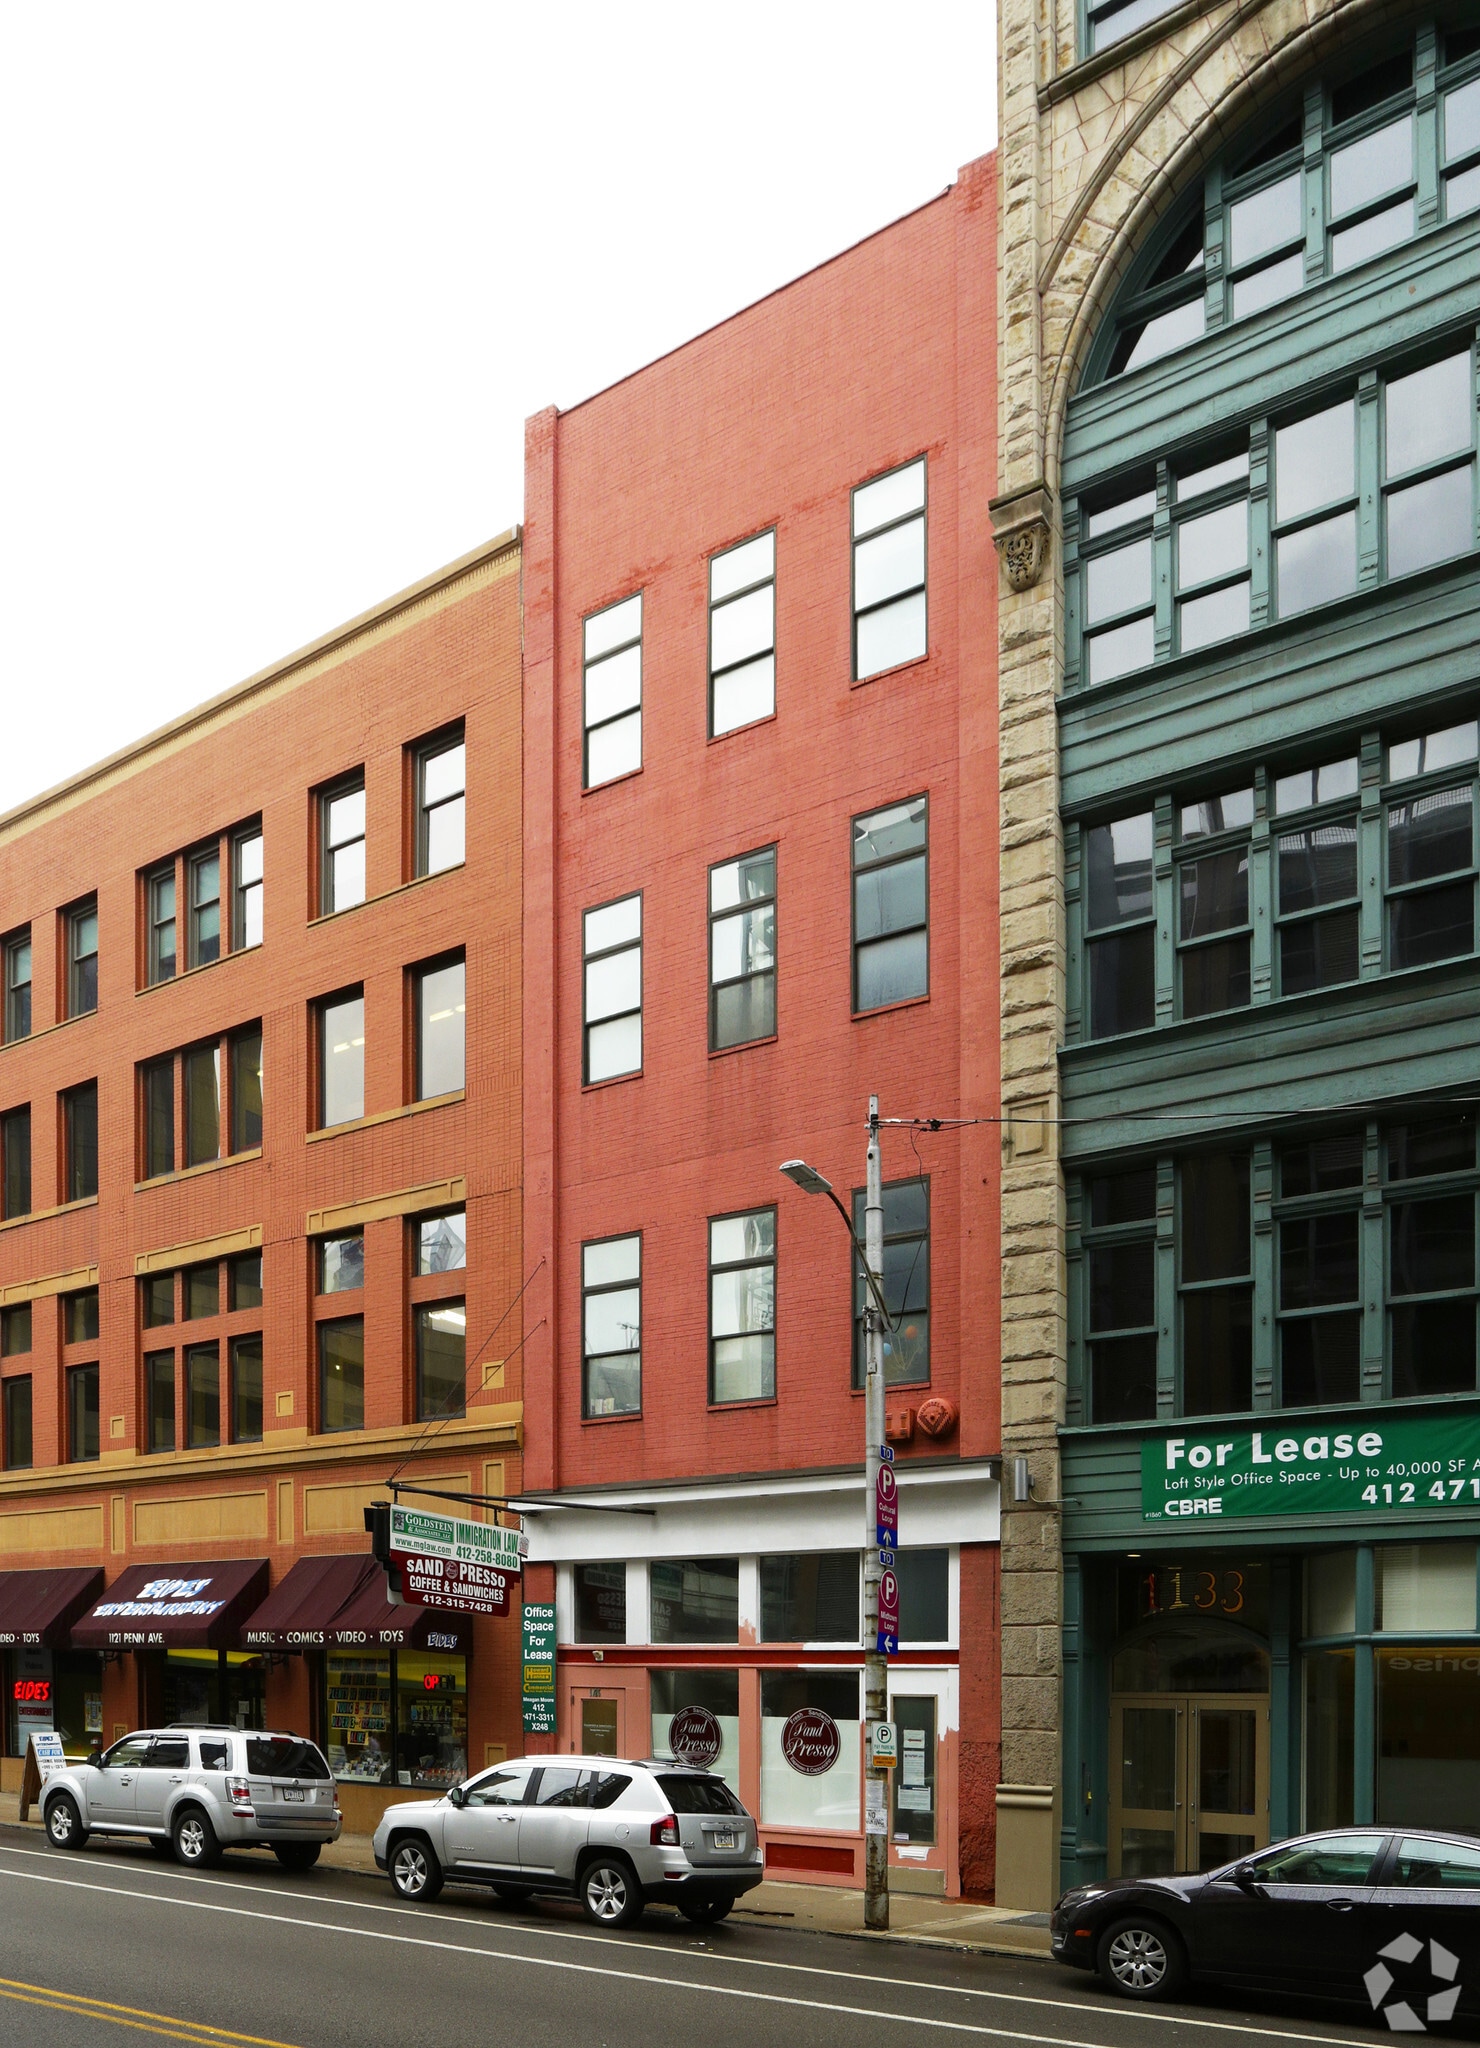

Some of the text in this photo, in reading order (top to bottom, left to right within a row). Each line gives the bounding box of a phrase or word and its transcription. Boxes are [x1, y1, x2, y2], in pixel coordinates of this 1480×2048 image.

[882, 1447, 891, 1459] TO
[1166, 1432, 1383, 1470] For Lease
[883, 1469, 892, 1493] P
[1164, 1476, 1189, 1490] Loft
[1194, 1475, 1225, 1490] Style
[1231, 1472, 1273, 1485] Office
[1279, 1470, 1321, 1485] Space
[1340, 1467, 1360, 1481] Up
[1366, 1466, 1380, 1477] to
[1386, 1461, 1441, 1477] 40,000
[1448, 1459, 1466, 1472] SF
[1361, 1478, 1480, 1504] 412 471
[879, 1502, 896, 1515] Cultural
[1164, 1497, 1223, 1516] CBRE
[405, 1513, 453, 1532] GOLDSTEIN
[882, 1513, 893, 1525] Loop
[408, 1526, 414, 1534] &
[395, 1537, 452, 1554] www.mglaw.com
[456, 1523, 519, 1554] IMMIGRATION LAW
[456, 1546, 518, 1568] 412-258-8080
[882, 1553, 892, 1563] TO
[407, 1559, 506, 1588] SAND PRESSO
[410, 1575, 503, 1601] COFFEE & SANDWICHES
[886, 1576, 895, 1600] P
[1143, 1570, 1244, 1617] 1133
[92, 1600, 226, 1616] ENTERTAINMENT
[422, 1594, 493, 1612] 412-315-7428
[524, 1606, 553, 1617] Office
[881, 1610, 897, 1622] Midtown
[523, 1620, 554, 1633] Space
[884, 1621, 894, 1632] Loop
[23, 1633, 39, 1643] TOYS
[109, 1633, 165, 1643] 1121 PENN AVE.
[247, 1630, 404, 1643] MUSIC COMICS VIDEO TOYS
[428, 1632, 458, 1648] EIDES
[529, 1635, 546, 1646] For
[524, 1649, 553, 1659] Lease
[424, 1674, 455, 1690] OPEN
[523, 1683, 554, 1692] Commercial
[14, 1681, 50, 1701] EIDES
[808, 1710, 831, 1725] Sandwich
[680, 1720, 708, 1733] Sand
[794, 1721, 825, 1737] Sand
[880, 1729, 888, 1740] P
[673, 1734, 717, 1752] Presso
[786, 1737, 835, 1757] Presso
